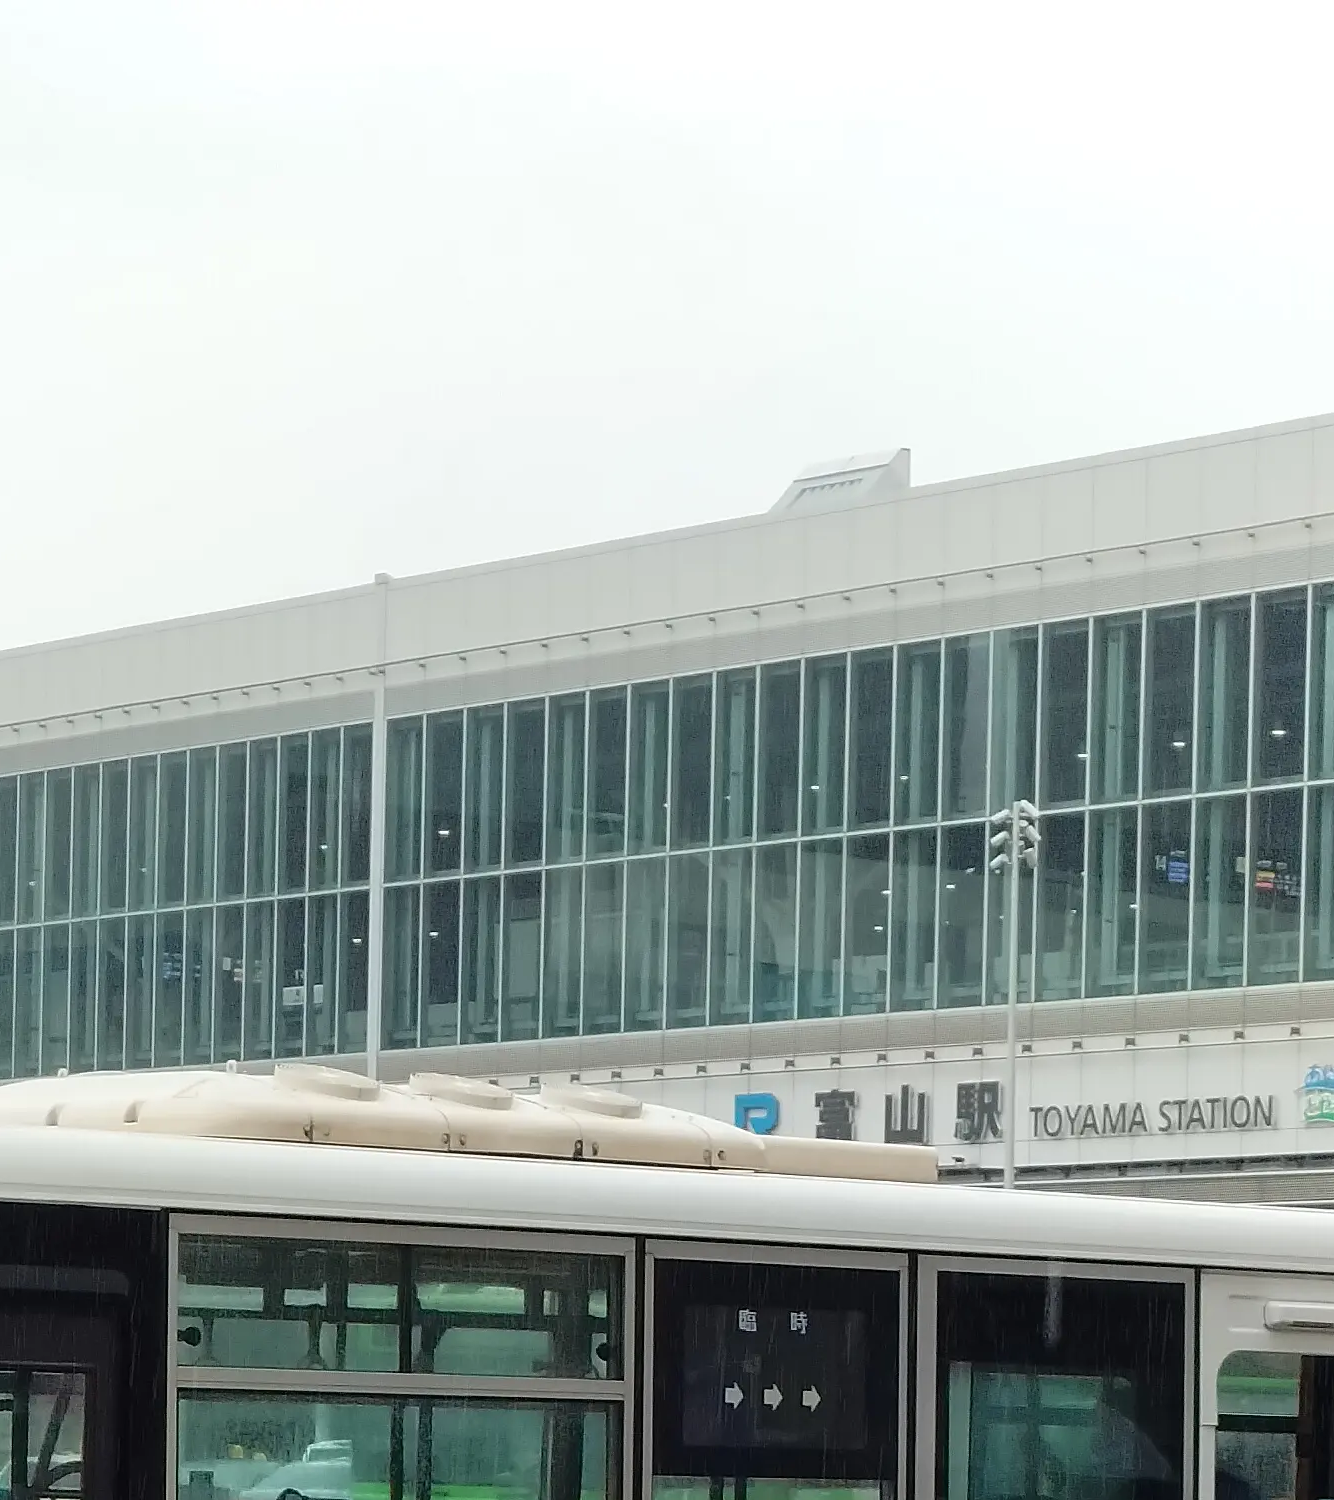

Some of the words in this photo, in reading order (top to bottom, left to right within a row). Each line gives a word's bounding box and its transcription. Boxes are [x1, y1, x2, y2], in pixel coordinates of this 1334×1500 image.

[814, 1079, 1004, 1144] 富山駅
[1029, 1101, 1148, 1138] TOYAMA
[1158, 1095, 1274, 1132] STATION
[738, 1308, 808, 1335] 臨時
